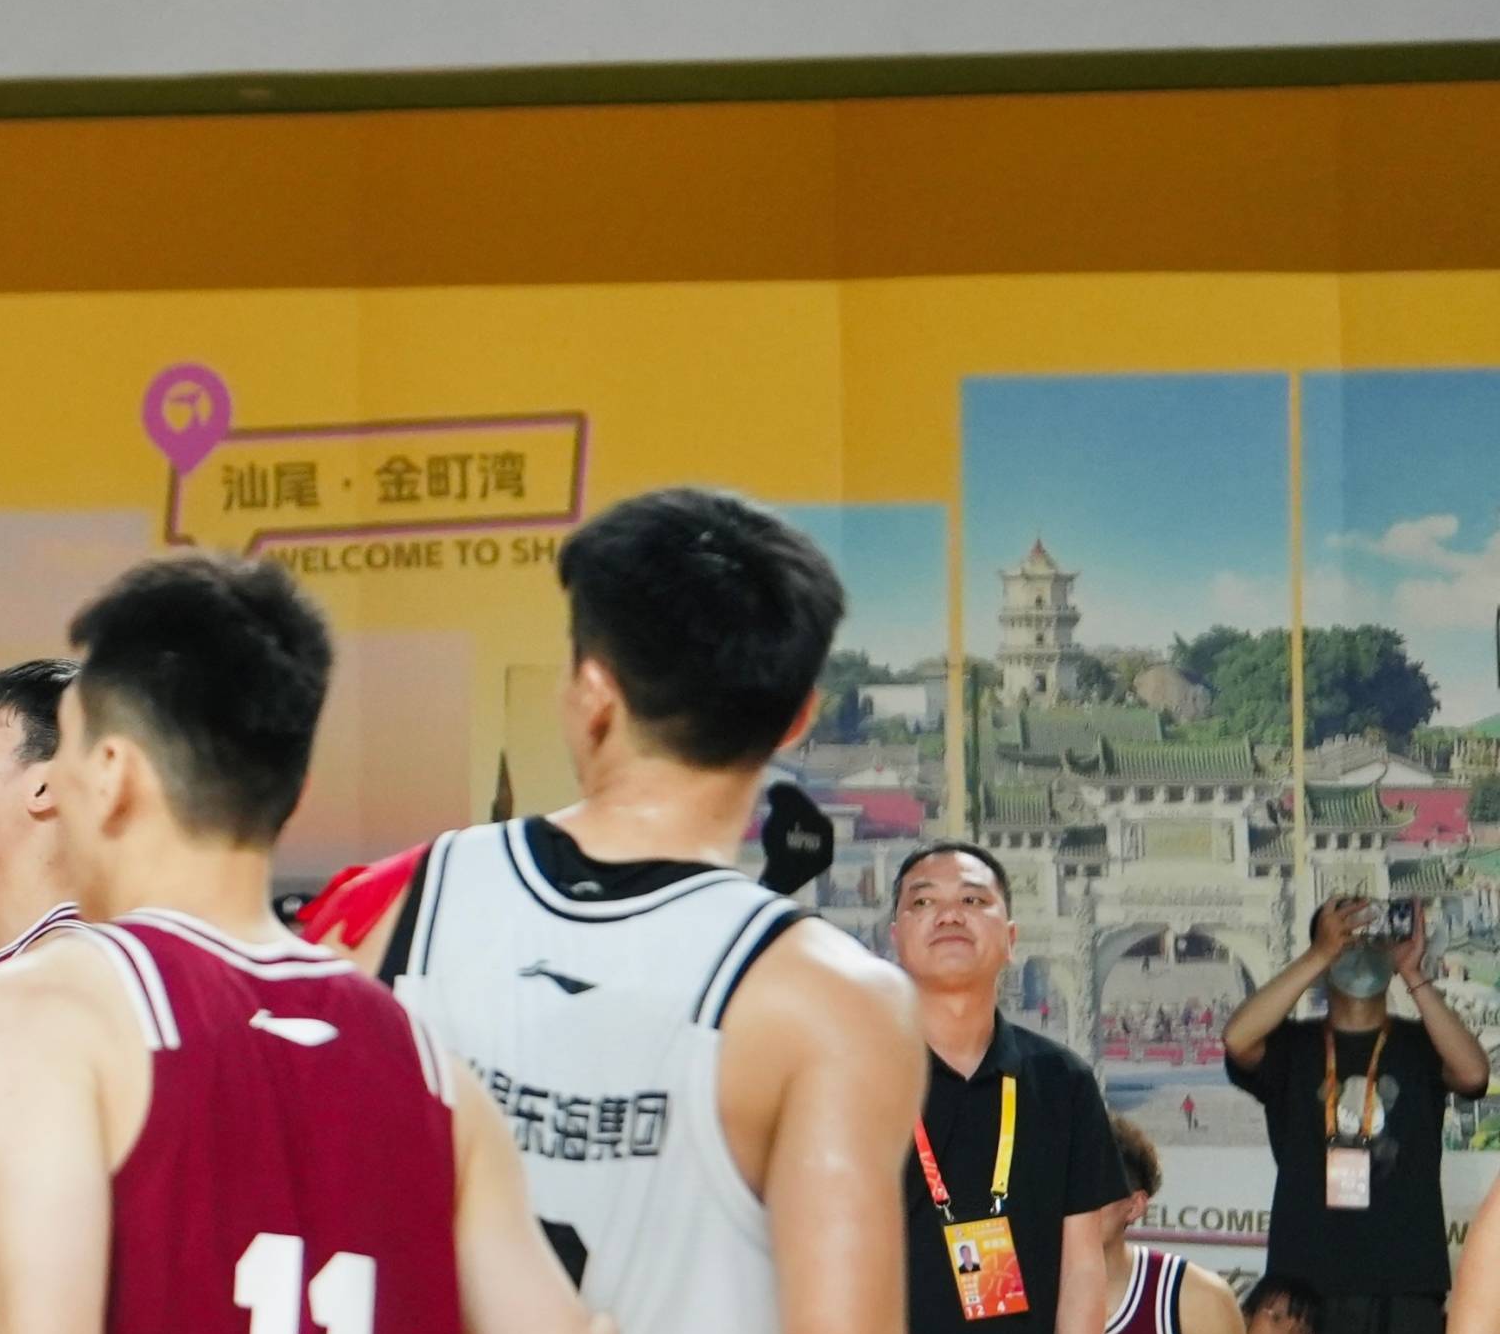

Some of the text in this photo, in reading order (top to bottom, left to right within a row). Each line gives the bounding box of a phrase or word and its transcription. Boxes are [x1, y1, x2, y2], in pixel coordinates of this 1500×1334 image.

[264, 542, 445, 575] WELCOME
[457, 538, 500, 567] TO
[1140, 1203, 1272, 1236] ELCOME
